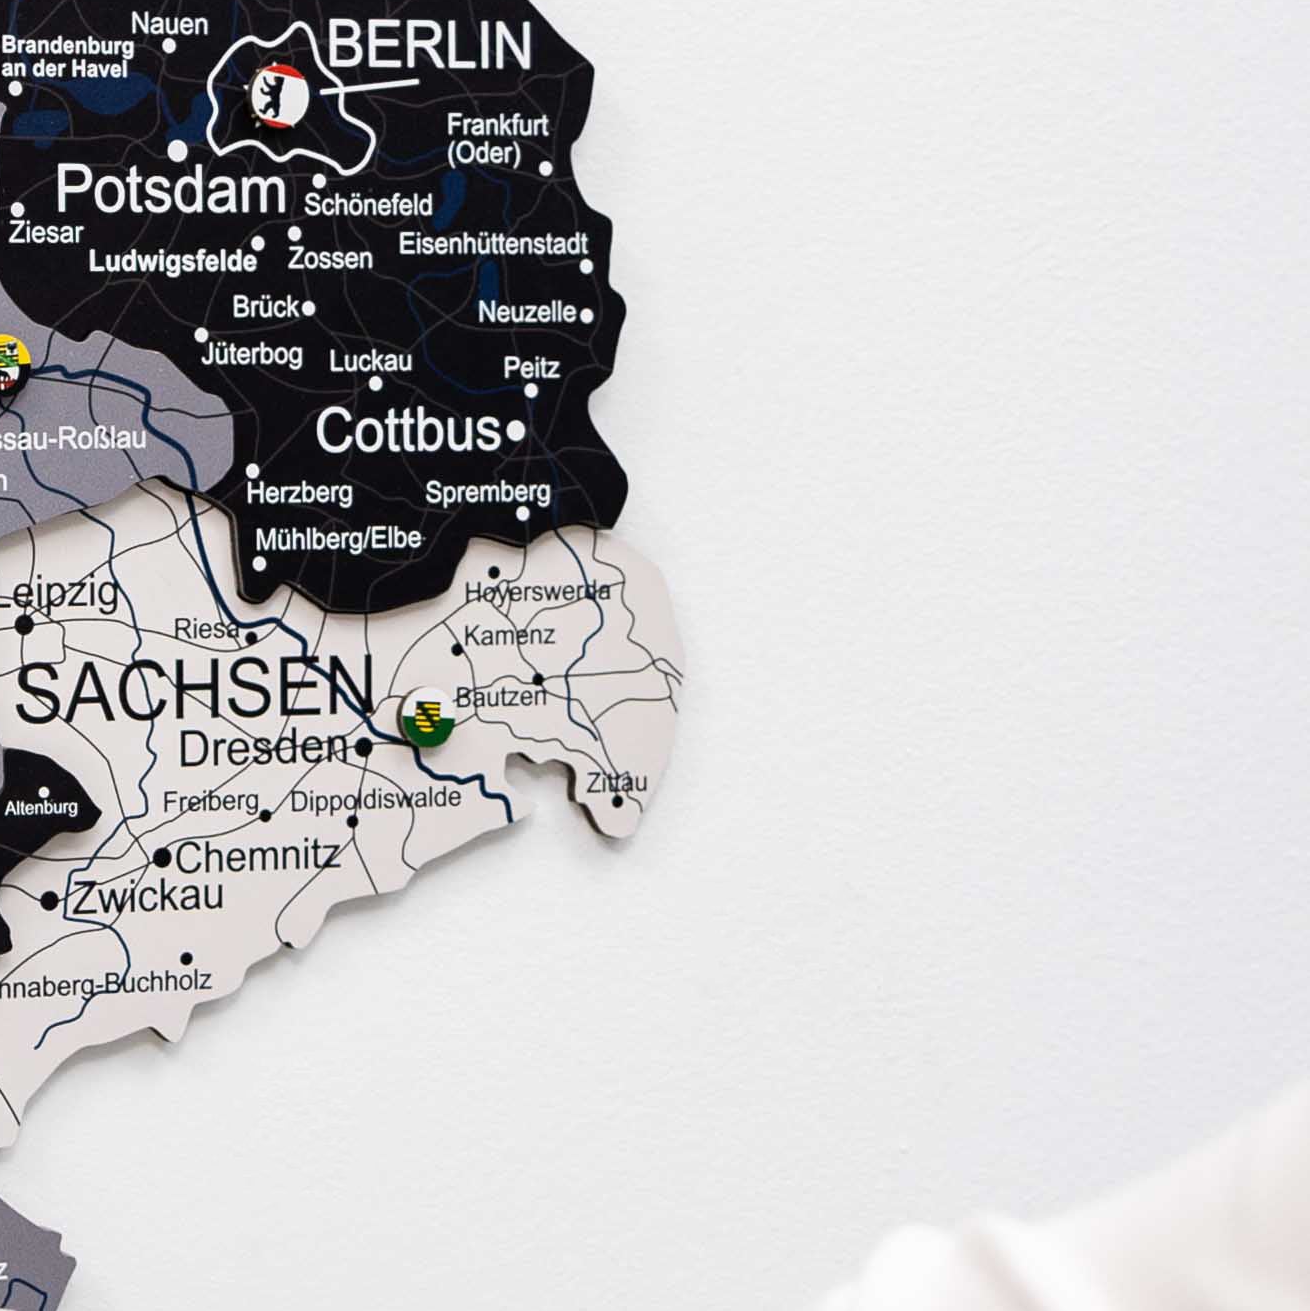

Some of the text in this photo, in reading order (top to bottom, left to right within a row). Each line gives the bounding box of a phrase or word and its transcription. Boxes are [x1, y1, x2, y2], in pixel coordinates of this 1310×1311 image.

[1, 36, 134, 59] Brandenburg
[330, 19, 530, 69] BERLIN
[2, 59, 127, 77] an der Havel
[449, 113, 548, 136] Frankfurt
[448, 141, 520, 168] (Oder)
[58, 163, 285, 213] Potsdam
[400, 232, 587, 254] Eisenhüttenstadt
[317, 406, 501, 453] Cottbus
[257, 526, 421, 554] Mühlberg/Elbe
[465, 623, 555, 647] Kamenz
[16, 652, 374, 725] SACHSEN
[180, 728, 348, 768] Dresden
[5, 800, 77, 817] Altenburg
[176, 839, 341, 875] Chemnitz
